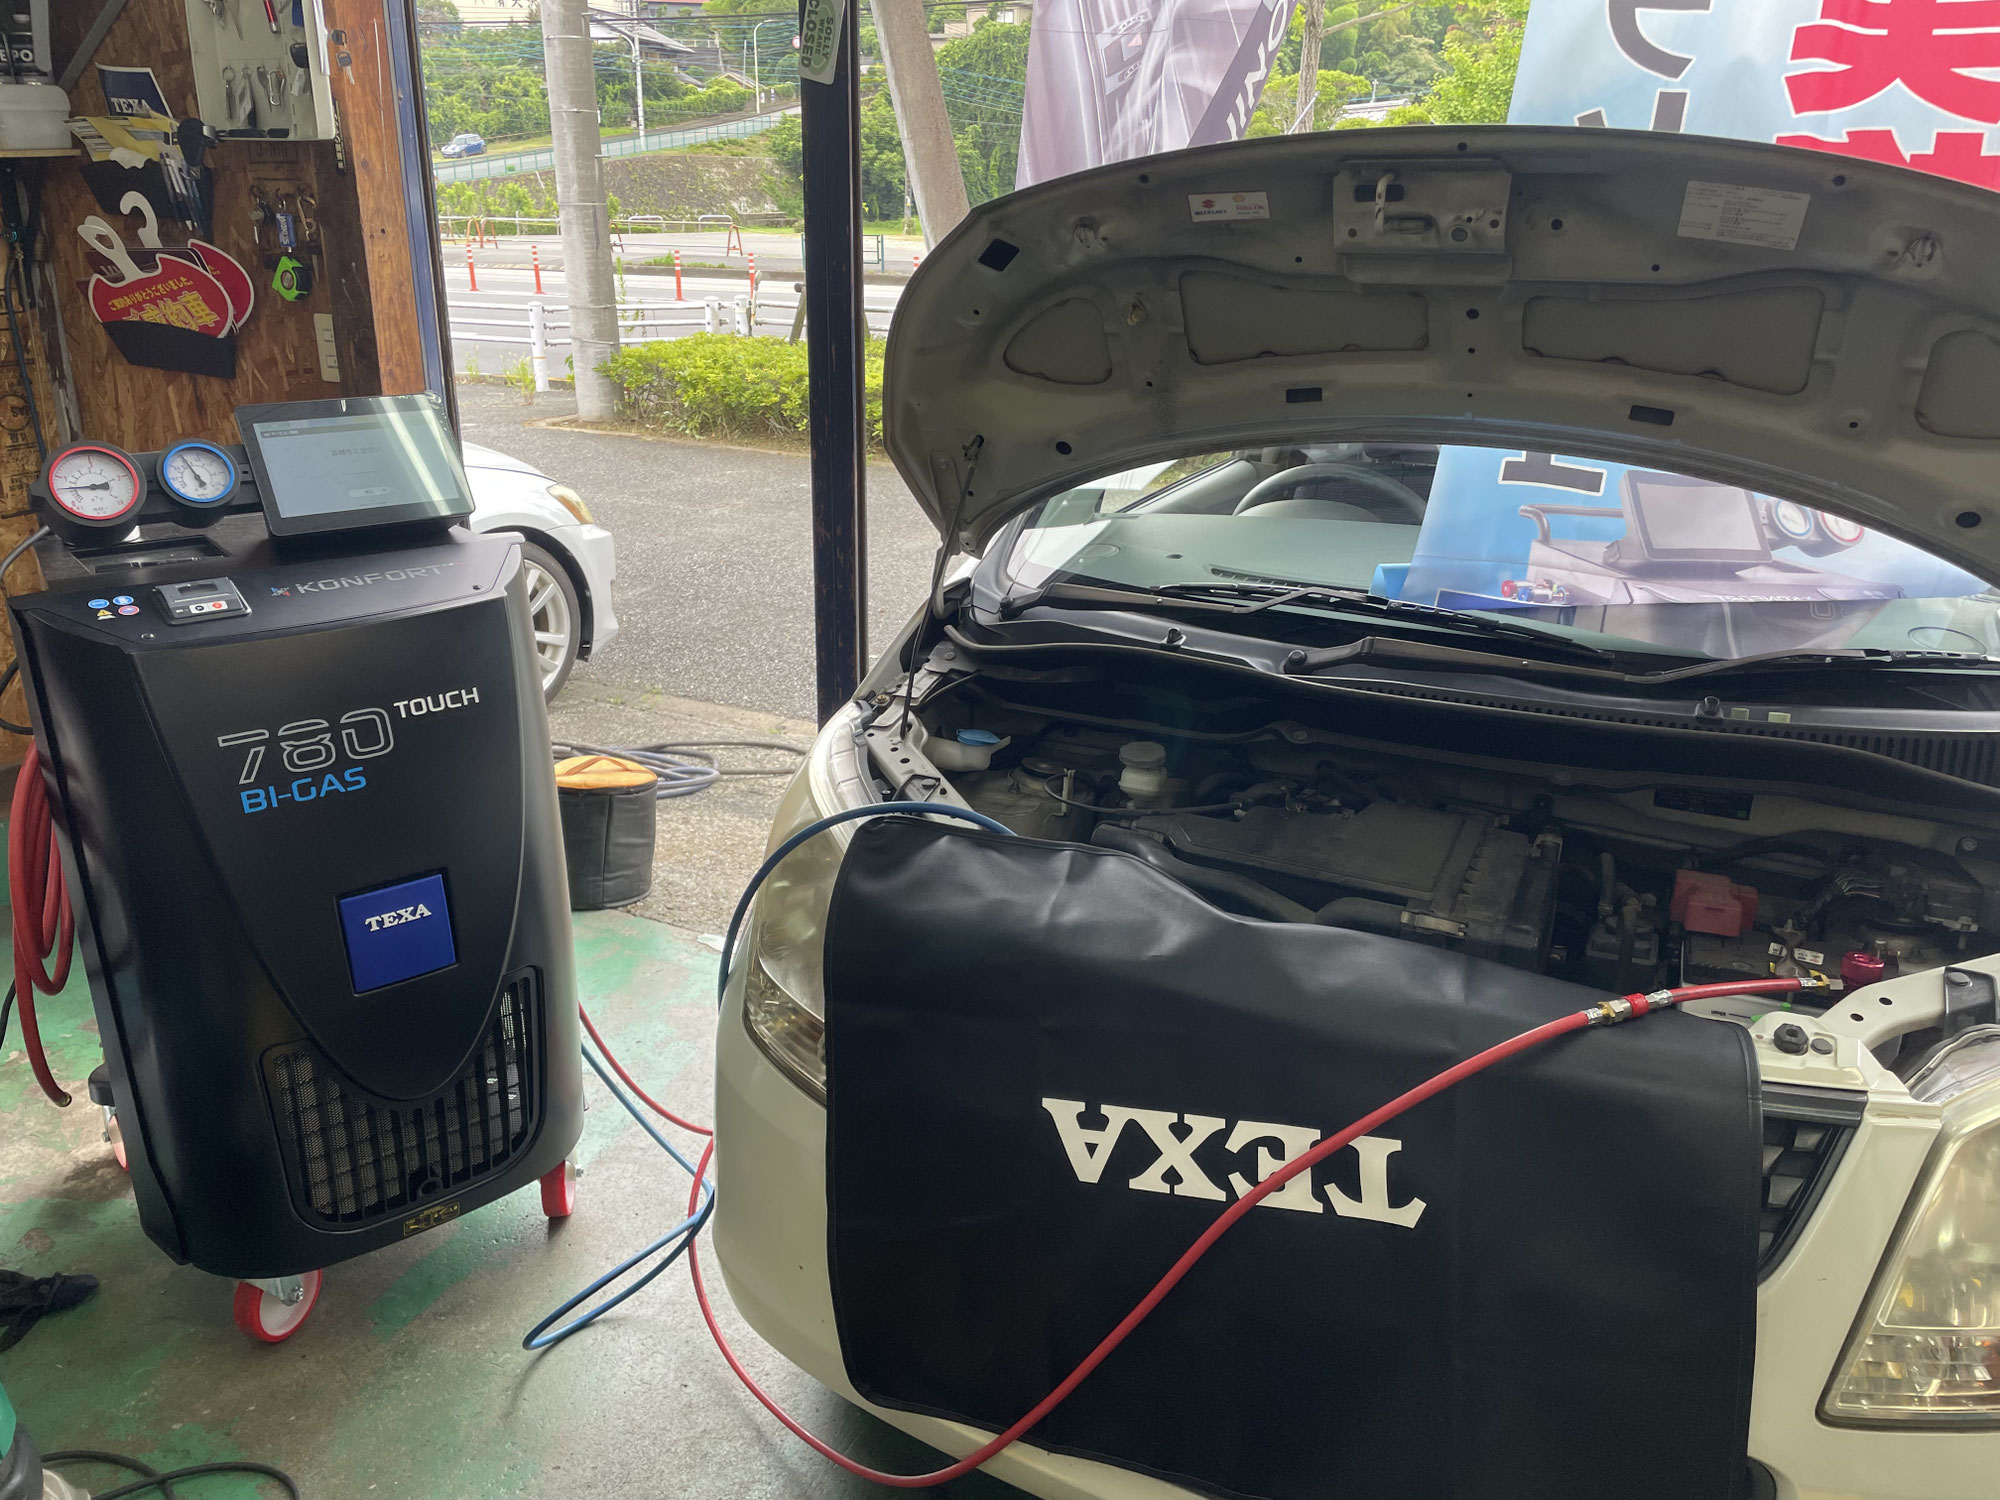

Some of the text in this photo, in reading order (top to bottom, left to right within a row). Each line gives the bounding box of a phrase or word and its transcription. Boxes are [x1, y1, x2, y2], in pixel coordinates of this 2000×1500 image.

[801, 0, 820, 68] CLOSED
[295, 564, 442, 594] KONFORT
[217, 686, 480, 786] 780 TOUCH
[239, 766, 368, 814] BI-GAS
[364, 901, 433, 932] TEXA
[1042, 1097, 1427, 1229] TEXA
